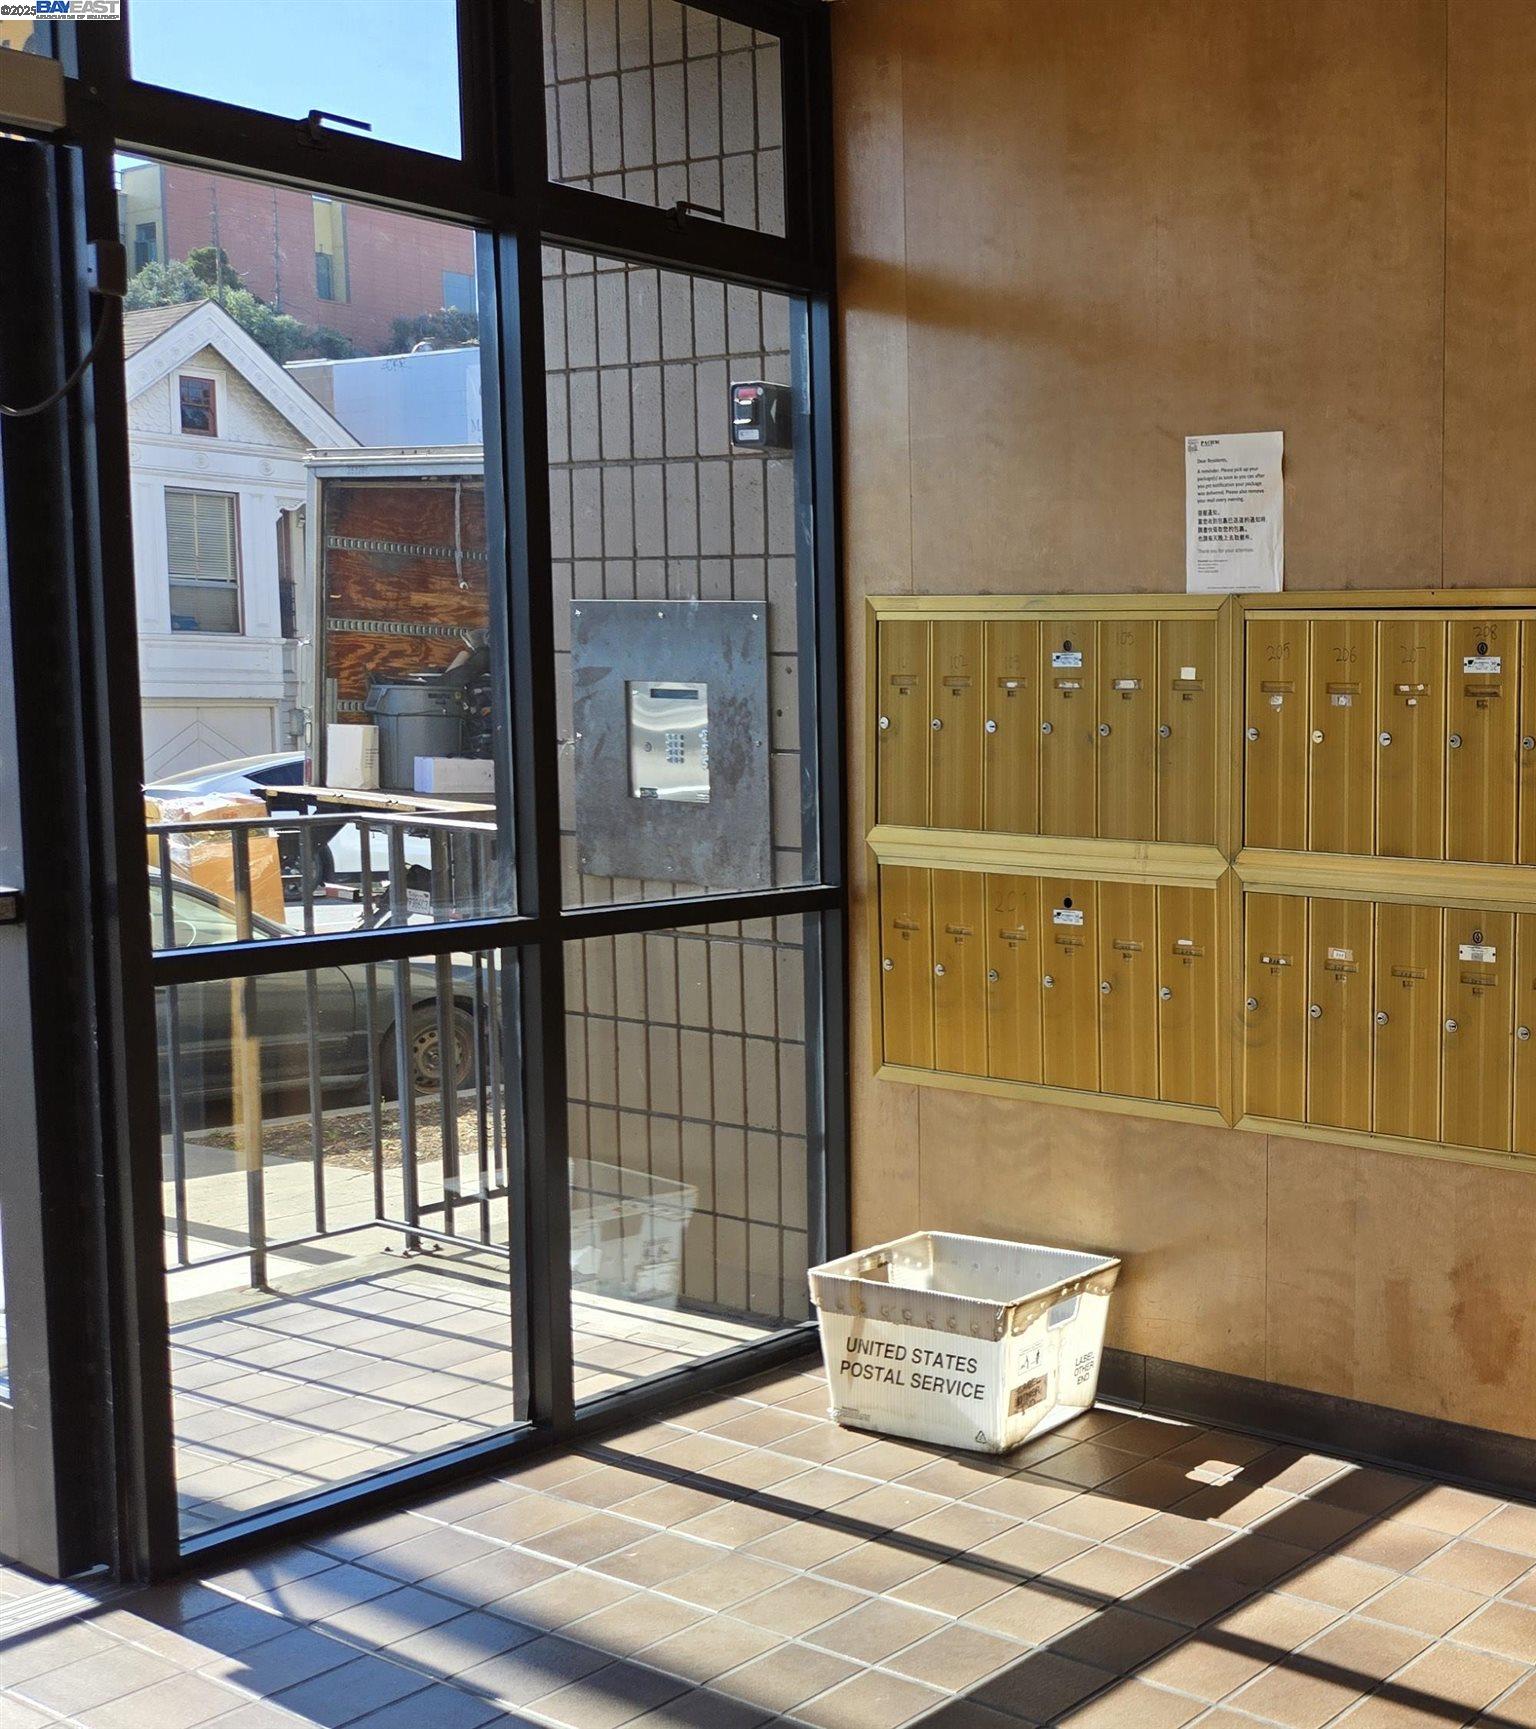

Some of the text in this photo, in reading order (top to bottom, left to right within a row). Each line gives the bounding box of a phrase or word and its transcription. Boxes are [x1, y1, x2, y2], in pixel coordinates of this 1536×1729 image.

[1472, 623, 1498, 641] 208
[1332, 646, 1358, 663] 206
[846, 1336, 978, 1374] UNITED STATES
[1073, 1360, 1094, 1377] OTHER
[840, 1360, 906, 1386] POSTAL
[910, 1373, 986, 1400] SERVICE
